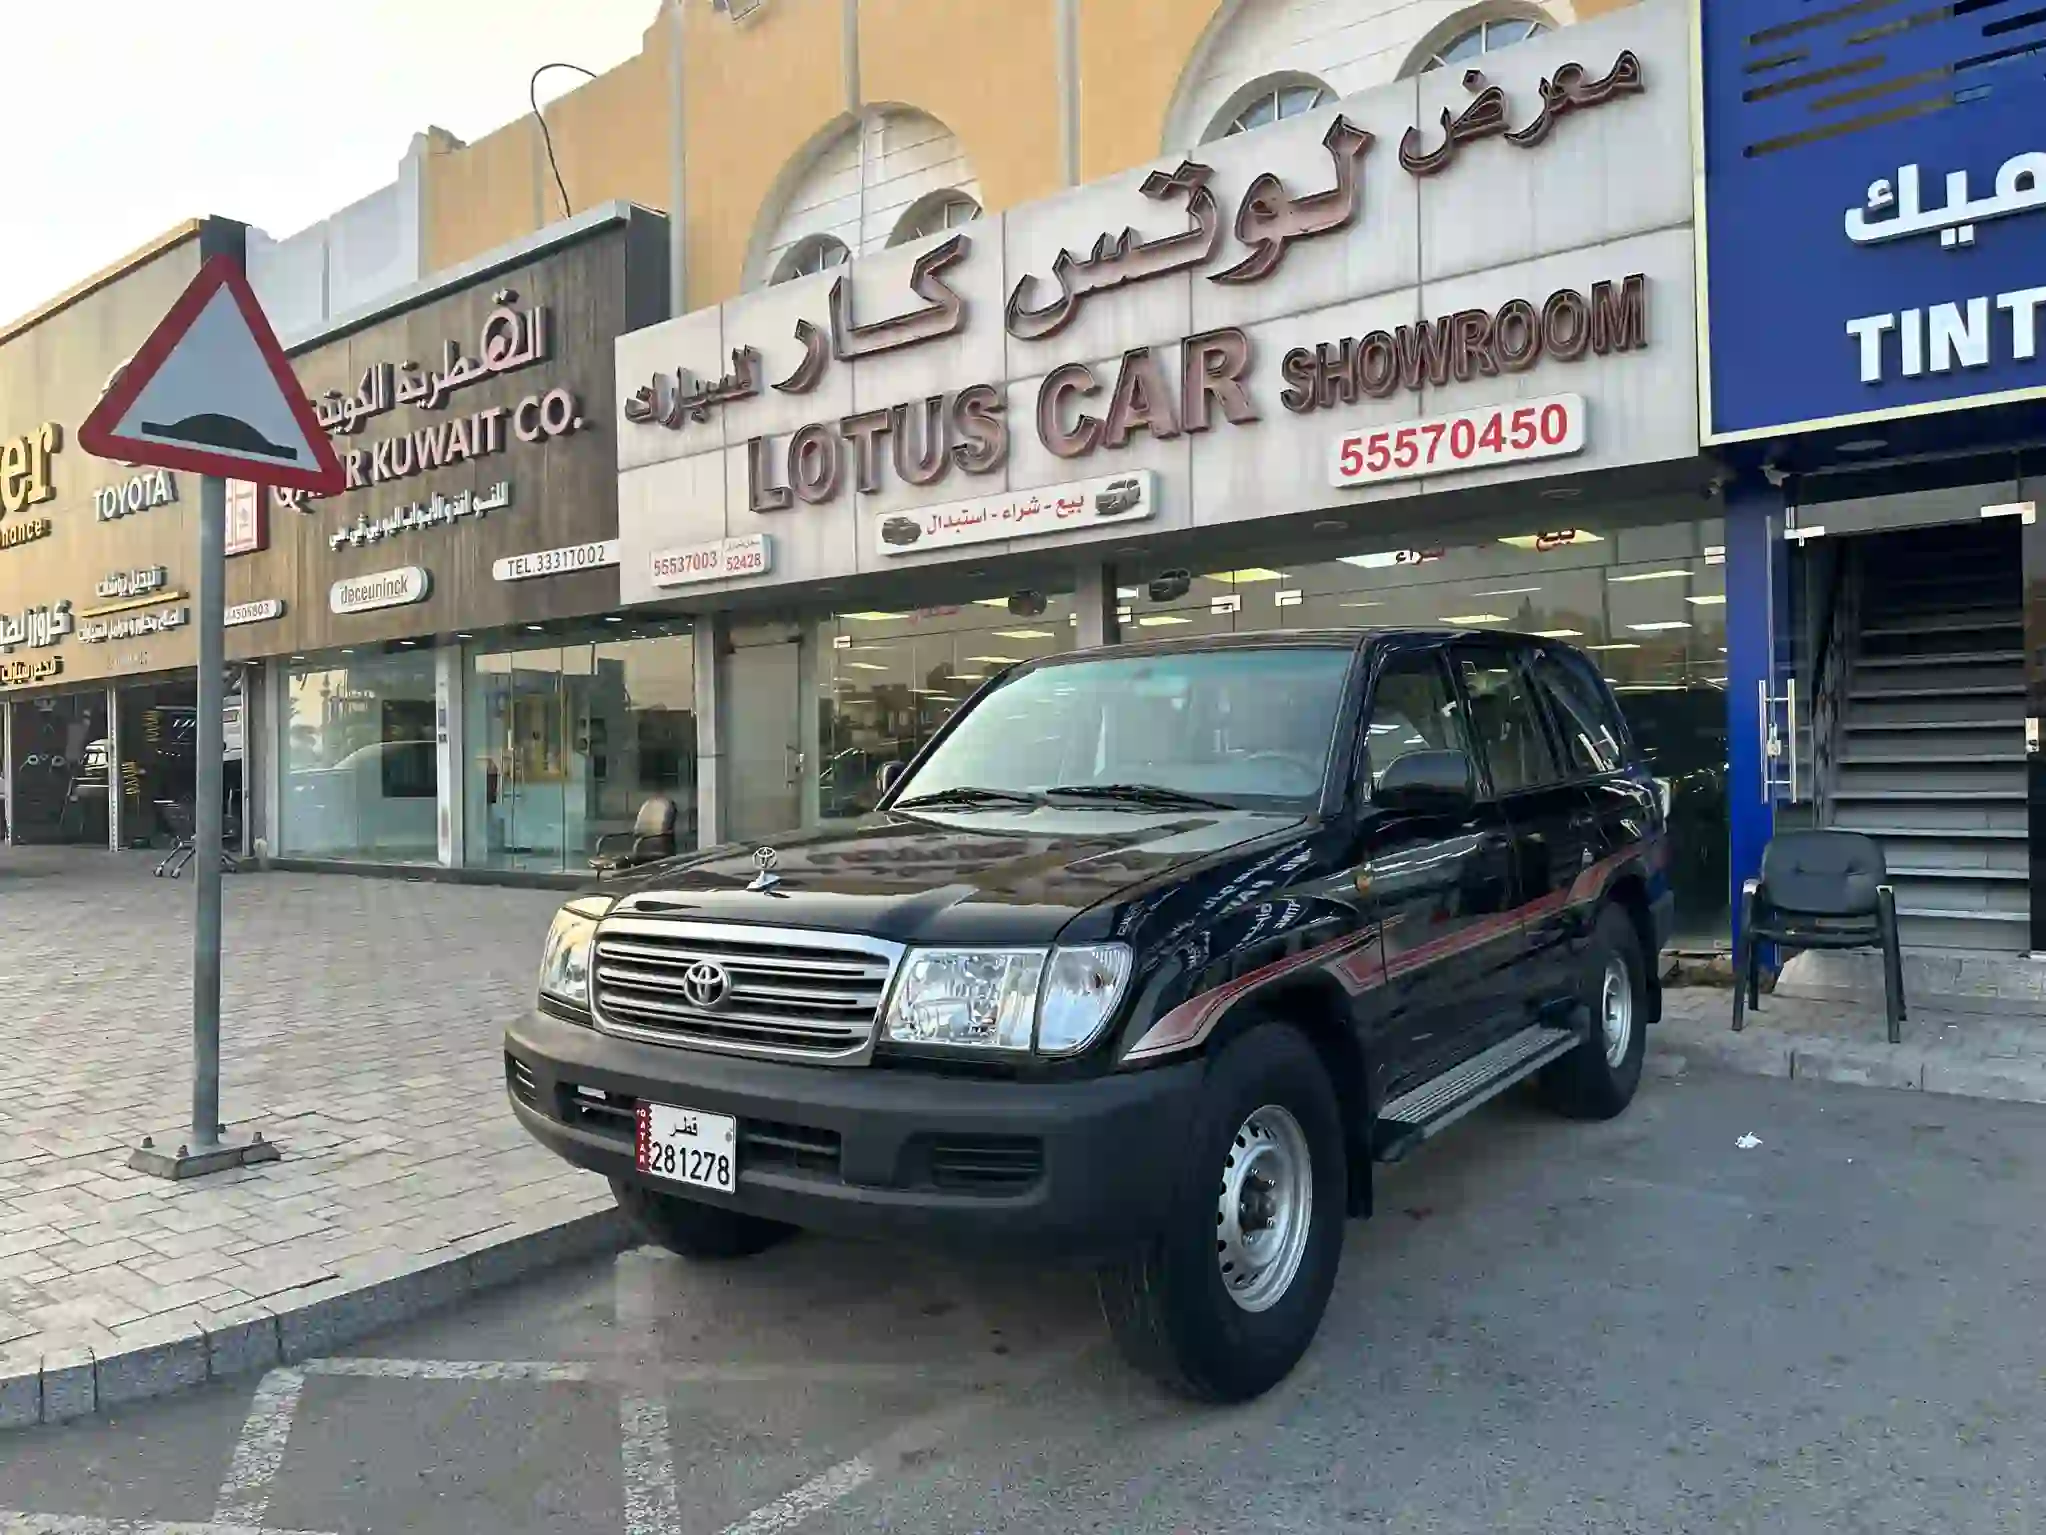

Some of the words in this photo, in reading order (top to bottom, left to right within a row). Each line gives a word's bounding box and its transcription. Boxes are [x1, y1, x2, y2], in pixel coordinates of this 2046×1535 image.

[1398, 49, 1644, 177] معرض
[1005, 112, 1375, 341] لوتس
[771, 233, 973, 394] كار
[1845, 286, 2046, 384] TINT
[396, 288, 550, 409] القطرية
[308, 361, 392, 434] الكويتي
[625, 344, 762, 431] للسيارات
[747, 383, 1007, 514] LOTUS
[1035, 325, 1261, 460] CAR
[1280, 272, 1649, 414] SHOWROOM
[373, 407, 505, 483] KUWAIT
[514, 387, 583, 443] CO.
[1338, 402, 1569, 478] 55570450
[93, 468, 172, 521] TOYOTA
[926, 507, 987, 535] استبدال
[1002, 496, 1041, 521] شراء
[1056, 494, 1085, 519] بيع
[507, 545, 606, 577] TEL.33317002
[654, 550, 718, 577] 55537003
[726, 552, 762, 571] 52428
[340, 575, 408, 605] deceuninck
[639, 1109, 647, 1164] QATAR
[670, 1116, 698, 1137] قطر
[651, 1141, 730, 1186] 281278
